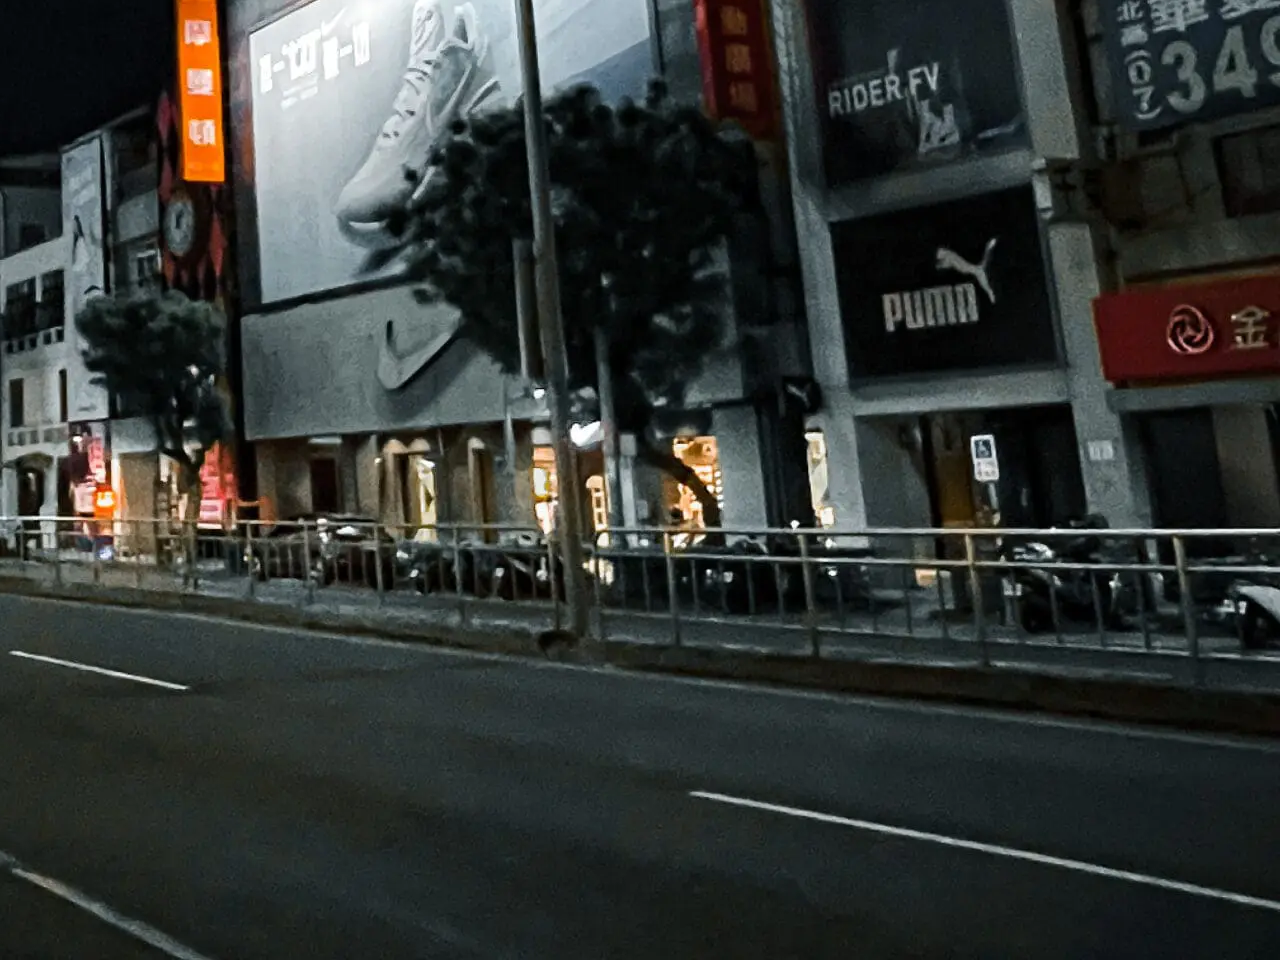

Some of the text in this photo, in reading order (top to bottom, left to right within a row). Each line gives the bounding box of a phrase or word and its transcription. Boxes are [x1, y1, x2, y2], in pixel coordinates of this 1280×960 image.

[828, 61, 940, 119] RIDER FV
[882, 282, 979, 332] PUMA
